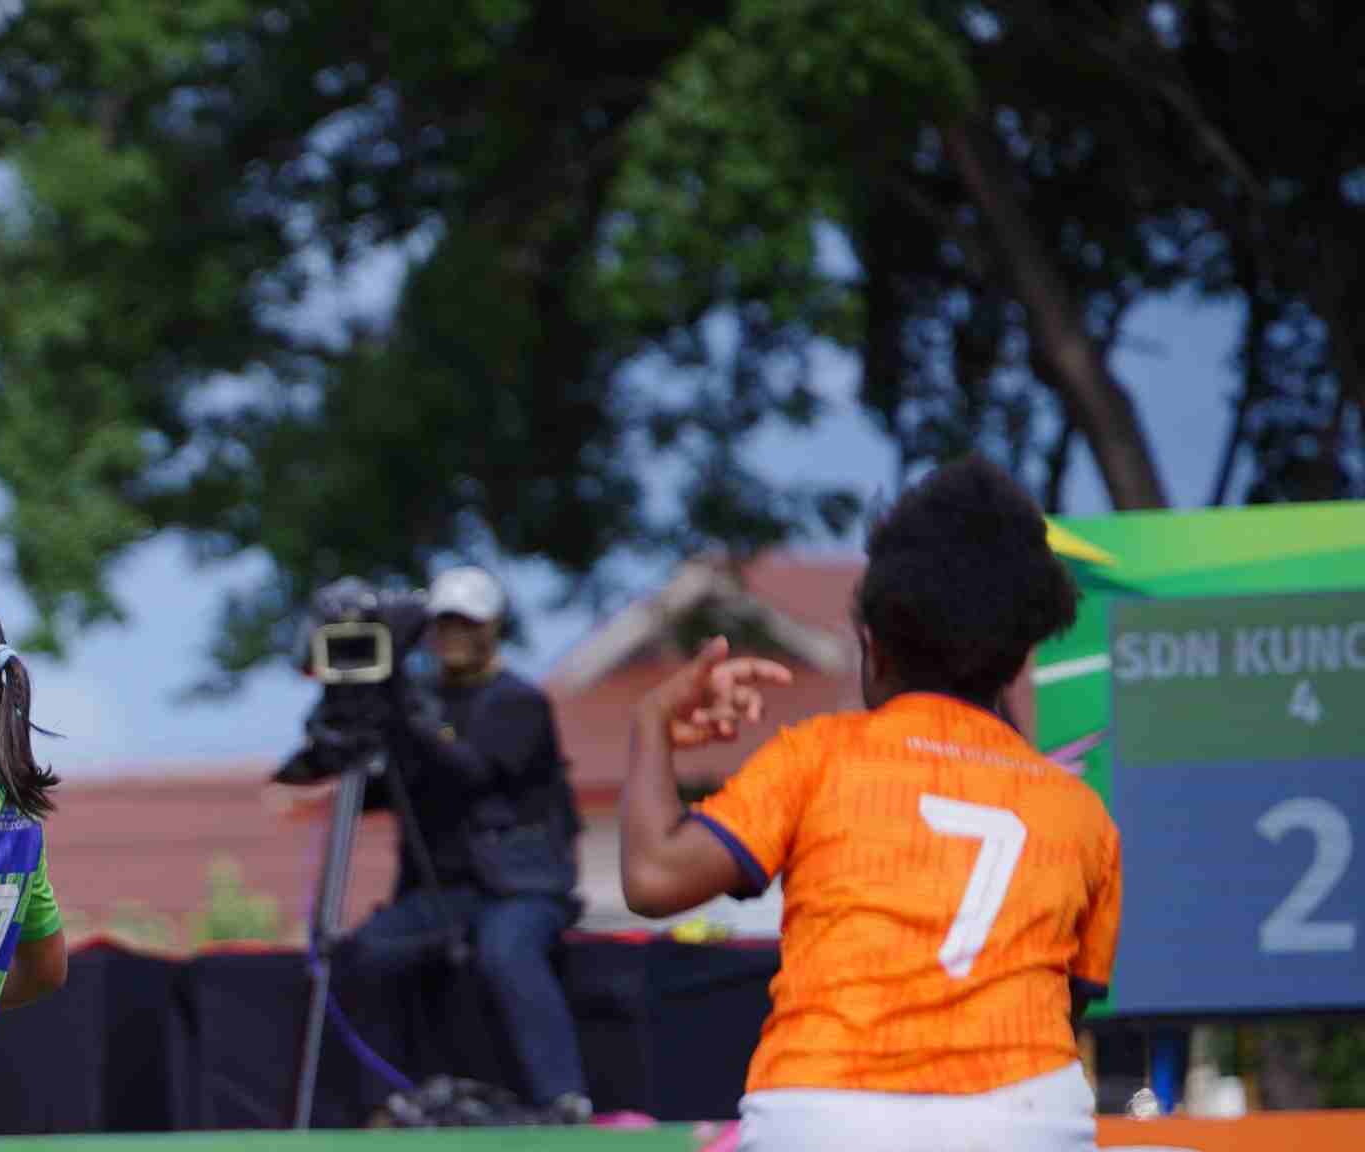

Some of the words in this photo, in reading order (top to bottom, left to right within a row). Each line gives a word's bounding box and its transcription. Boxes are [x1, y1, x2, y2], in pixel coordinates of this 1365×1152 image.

[1115, 631, 1221, 681] SDN
[1287, 680, 1324, 727] 4
[918, 793, 1027, 978] 7
[1256, 797, 1356, 953] 2
